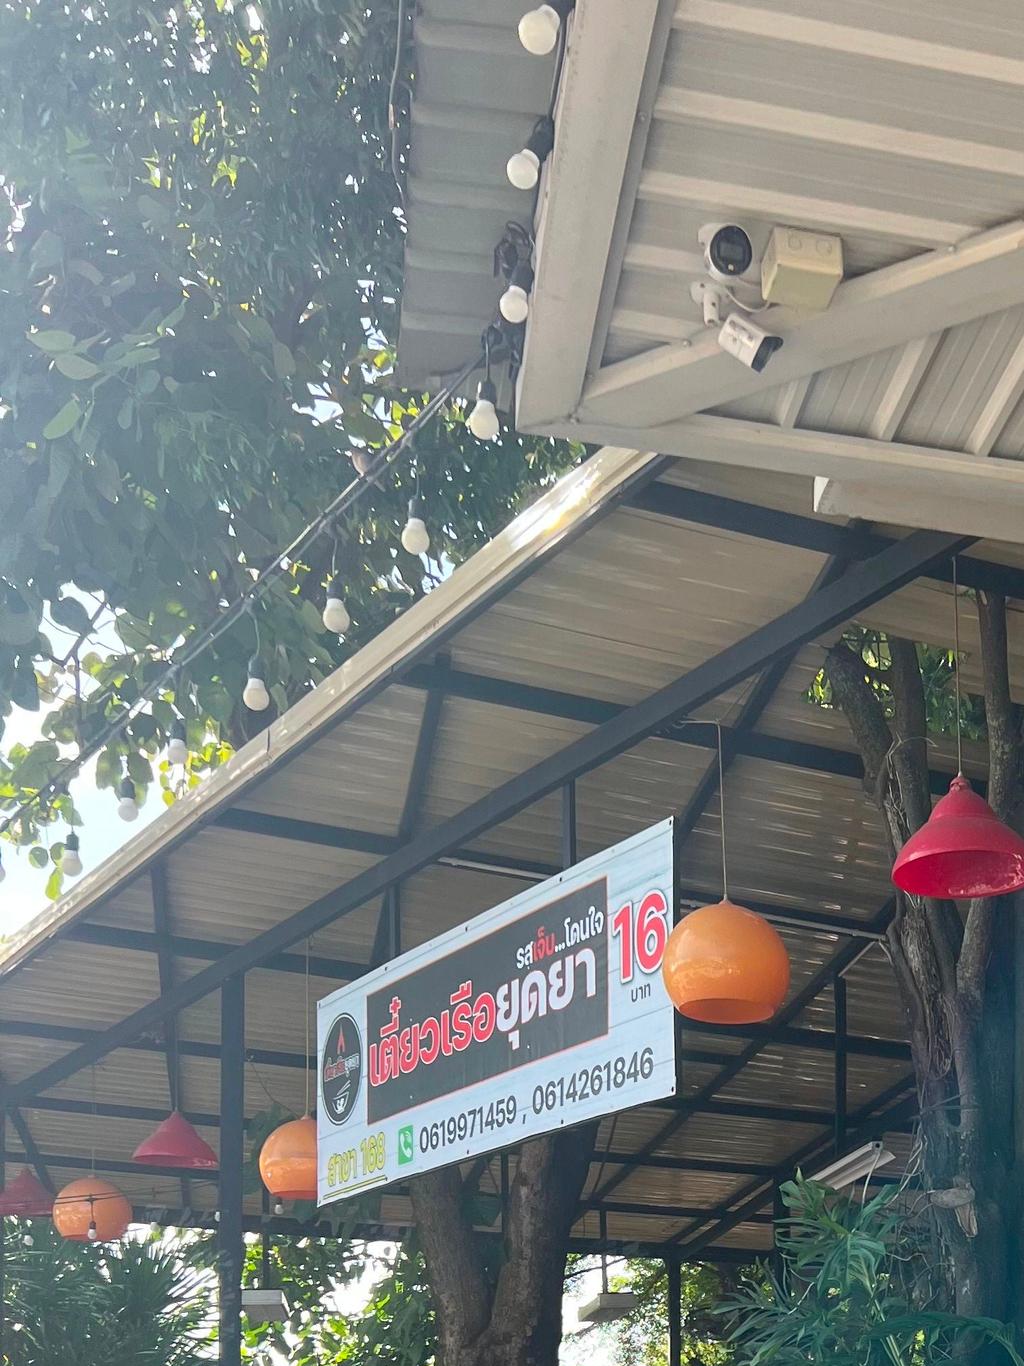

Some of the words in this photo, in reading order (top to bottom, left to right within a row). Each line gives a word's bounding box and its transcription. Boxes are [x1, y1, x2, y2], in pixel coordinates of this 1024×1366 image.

[612, 888, 669, 985] 16
[369, 947, 598, 1087] เตี๋ยวเรือยุดยา
[631, 983, 651, 1003] บาท
[420, 1096, 517, 1154] 0619971459
[532, 1047, 655, 1116] 0614261846
[360, 1131, 386, 1176] 168
